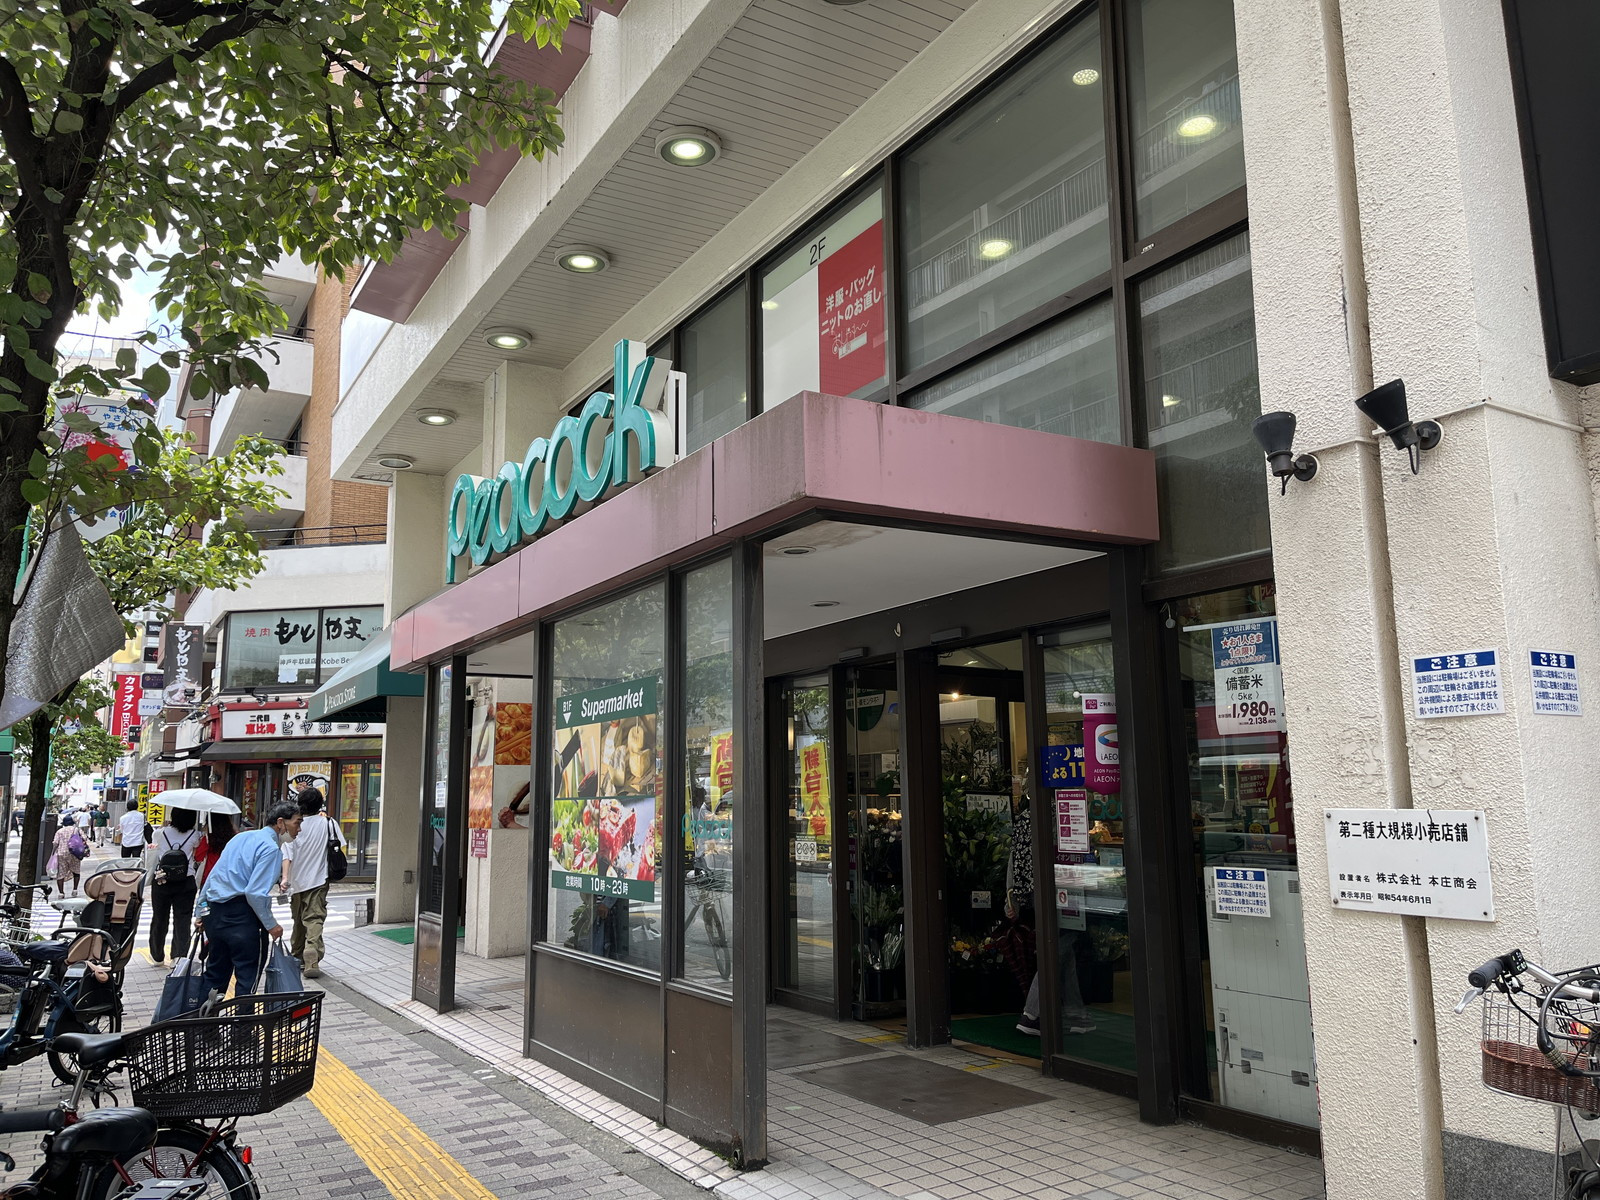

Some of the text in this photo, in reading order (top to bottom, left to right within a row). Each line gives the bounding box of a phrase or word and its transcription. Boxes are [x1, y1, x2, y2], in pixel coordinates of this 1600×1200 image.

[809, 236, 827, 266] 2F
[825, 265, 876, 313] 洋服・バッグ
[821, 287, 882, 336] ニットのお直し
[446, 338, 662, 584] peacock
[245, 627, 271, 638] 焼肉
[1430, 653, 1478, 670] ご注意
[1540, 653, 1568, 667] ご注意
[1225, 674, 1264, 691] 備蓄米
[1416, 669, 1497, 684] 当施設には駐輪場はございません
[122, 676, 135, 711] カラオケ
[1418, 680, 1497, 694] この周辺に駐輪され盗難または
[563, 687, 644, 720] B1F Supermarket
[1418, 691, 1499, 705] 公共機関による撤去には責任を
[249, 714, 270, 722] 二代目
[1233, 701, 1276, 719] 1,980円
[246, 724, 277, 735] 恵比寿
[1101, 753, 1120, 761] iAEO
[1338, 820, 1469, 843] 第二種大規模小売店舗
[1225, 870, 1255, 881] ご注意
[1339, 872, 1477, 890] 設置者名 株式会社 本庄商会
[1340, 890, 1432, 905] 表示年月日 昭和54年6月1日
